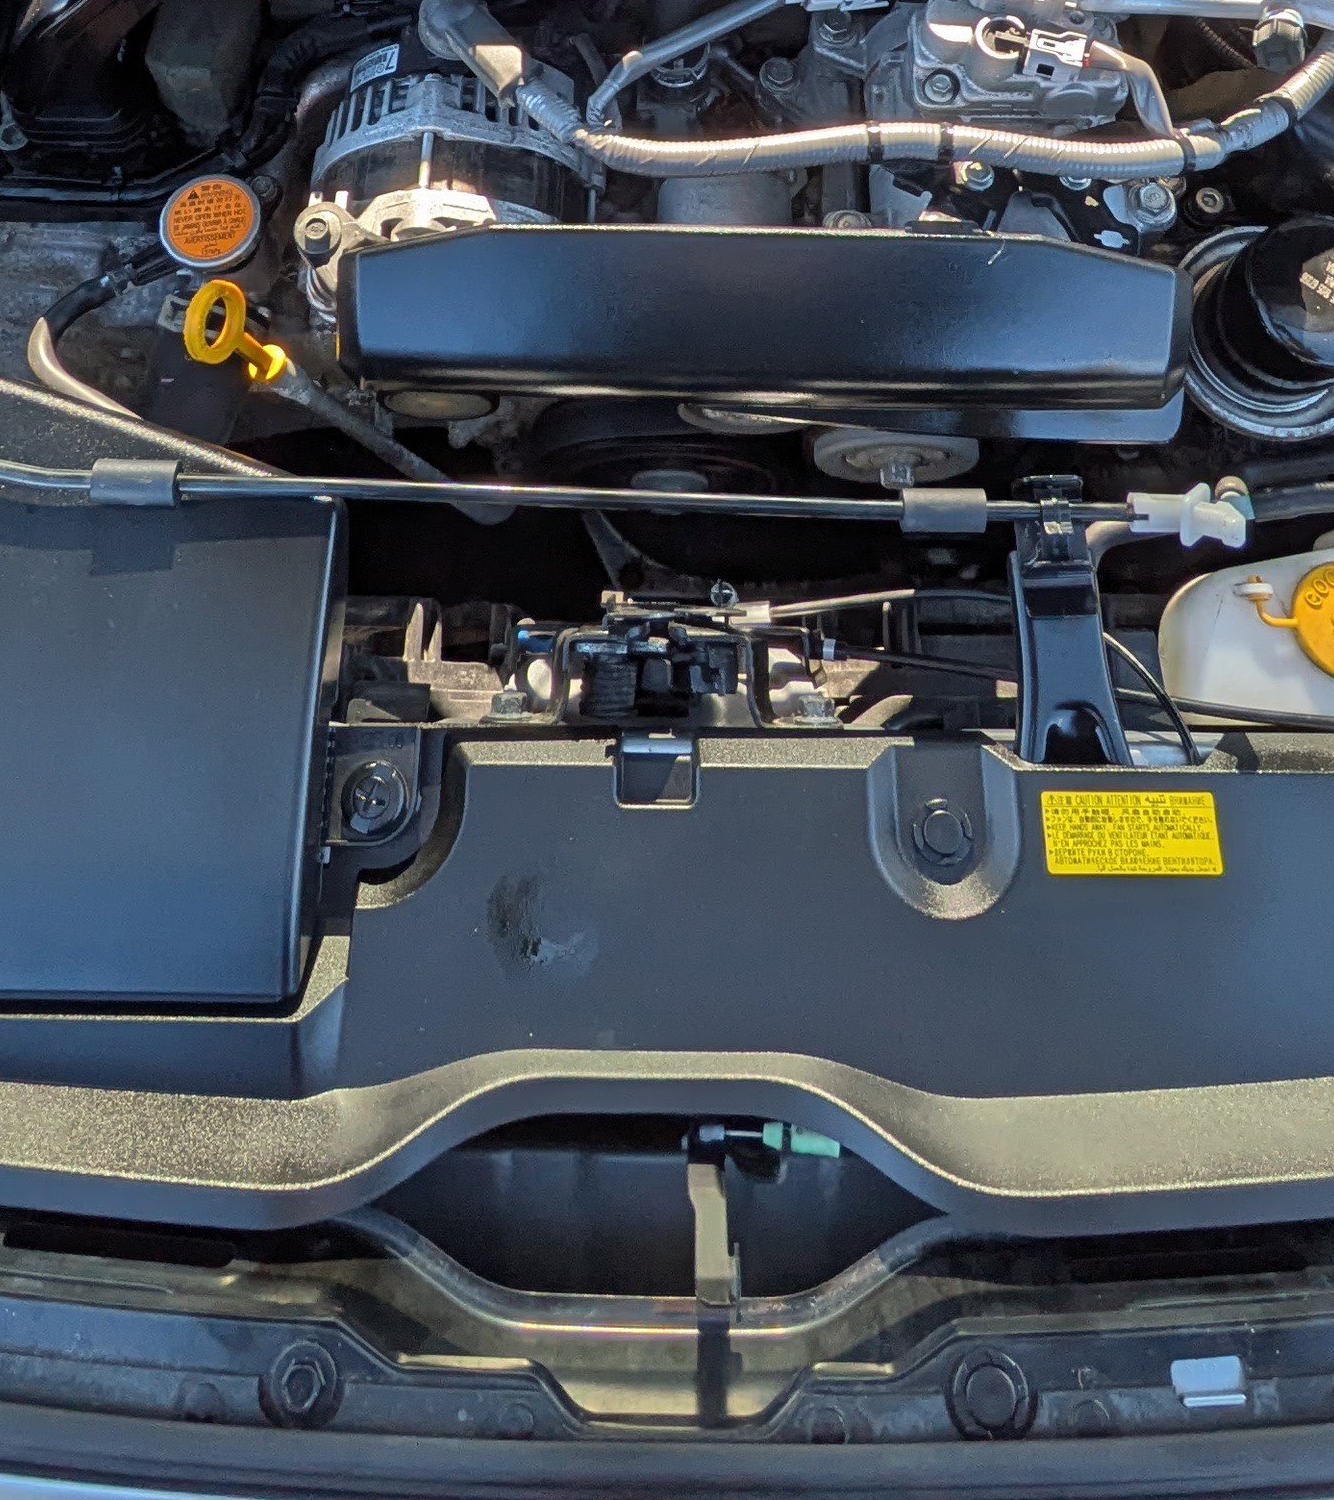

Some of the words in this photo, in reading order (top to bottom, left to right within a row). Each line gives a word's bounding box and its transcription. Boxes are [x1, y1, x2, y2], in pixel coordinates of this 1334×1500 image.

[1075, 795, 1102, 806] CAUTION
[1106, 795, 1141, 806] ATTENTION
[1108, 832, 1148, 840] VENTILATEUR
